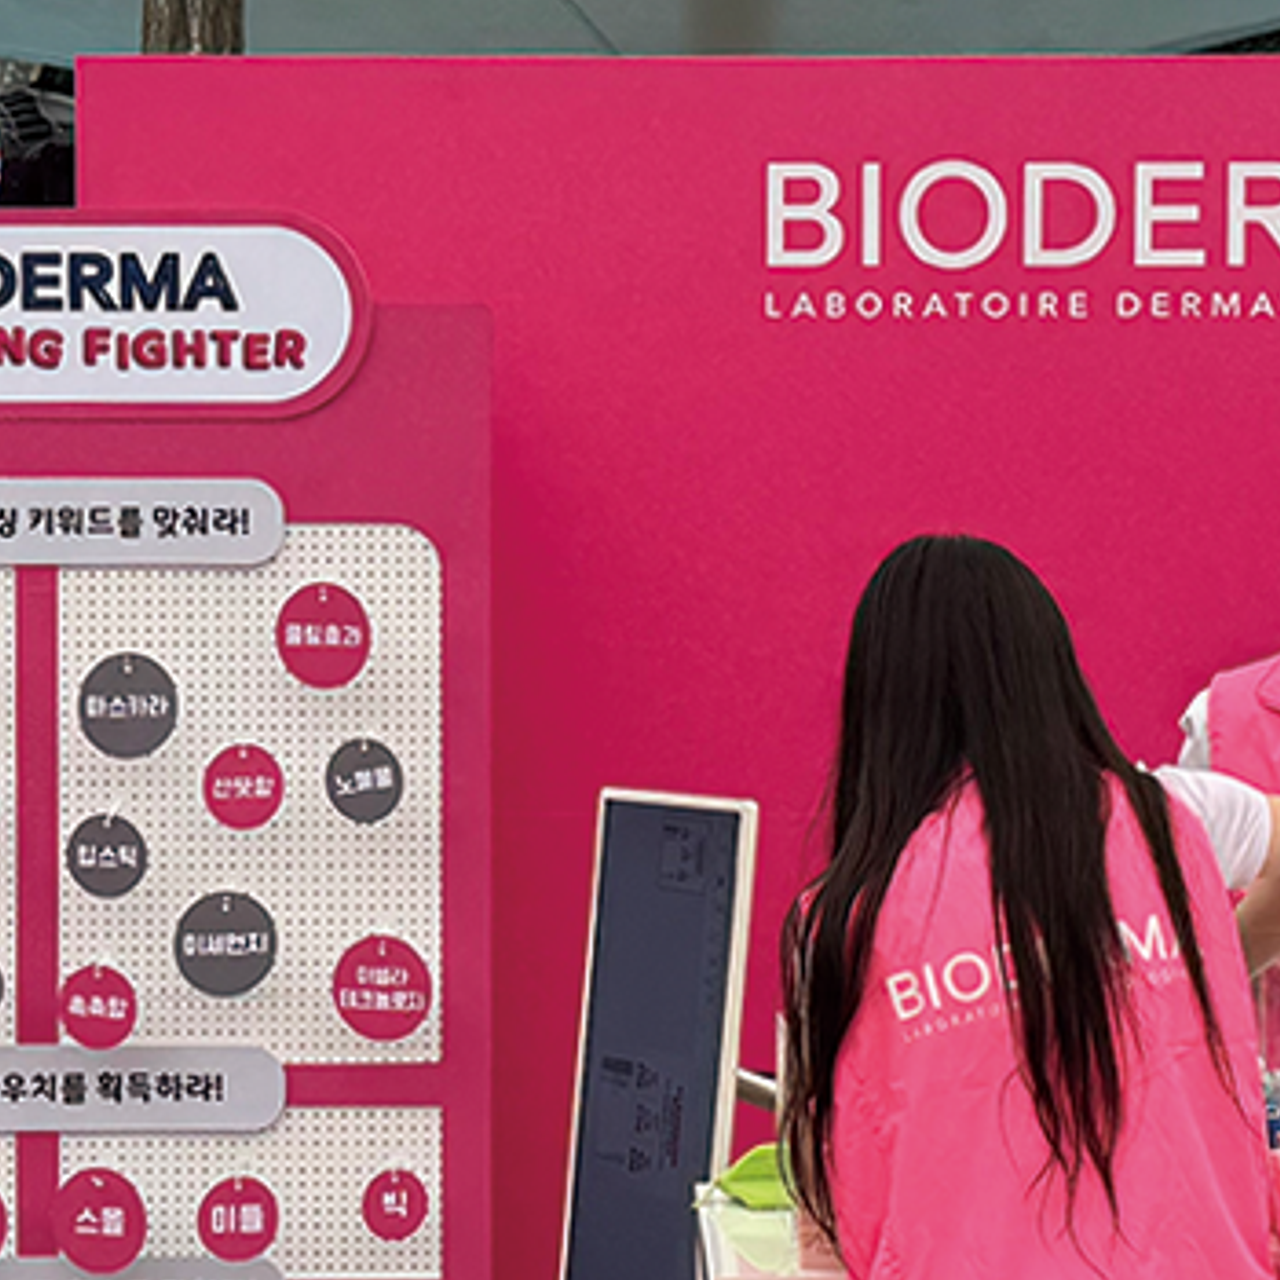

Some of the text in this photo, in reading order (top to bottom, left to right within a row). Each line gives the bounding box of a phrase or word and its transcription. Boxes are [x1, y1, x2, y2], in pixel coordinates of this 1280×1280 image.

[764, 290, 1090, 319] LABORATOIRE
[83, 326, 307, 372] FIGHTER
[28, 507, 143, 538] 키워드를
[152, 507, 250, 538] 맞춰라!
[85, 693, 171, 719] 마스카라
[76, 843, 139, 869] 립스틱
[96, 1071, 225, 1104] 획득하라!
[381, 1190, 409, 1219] 빅
